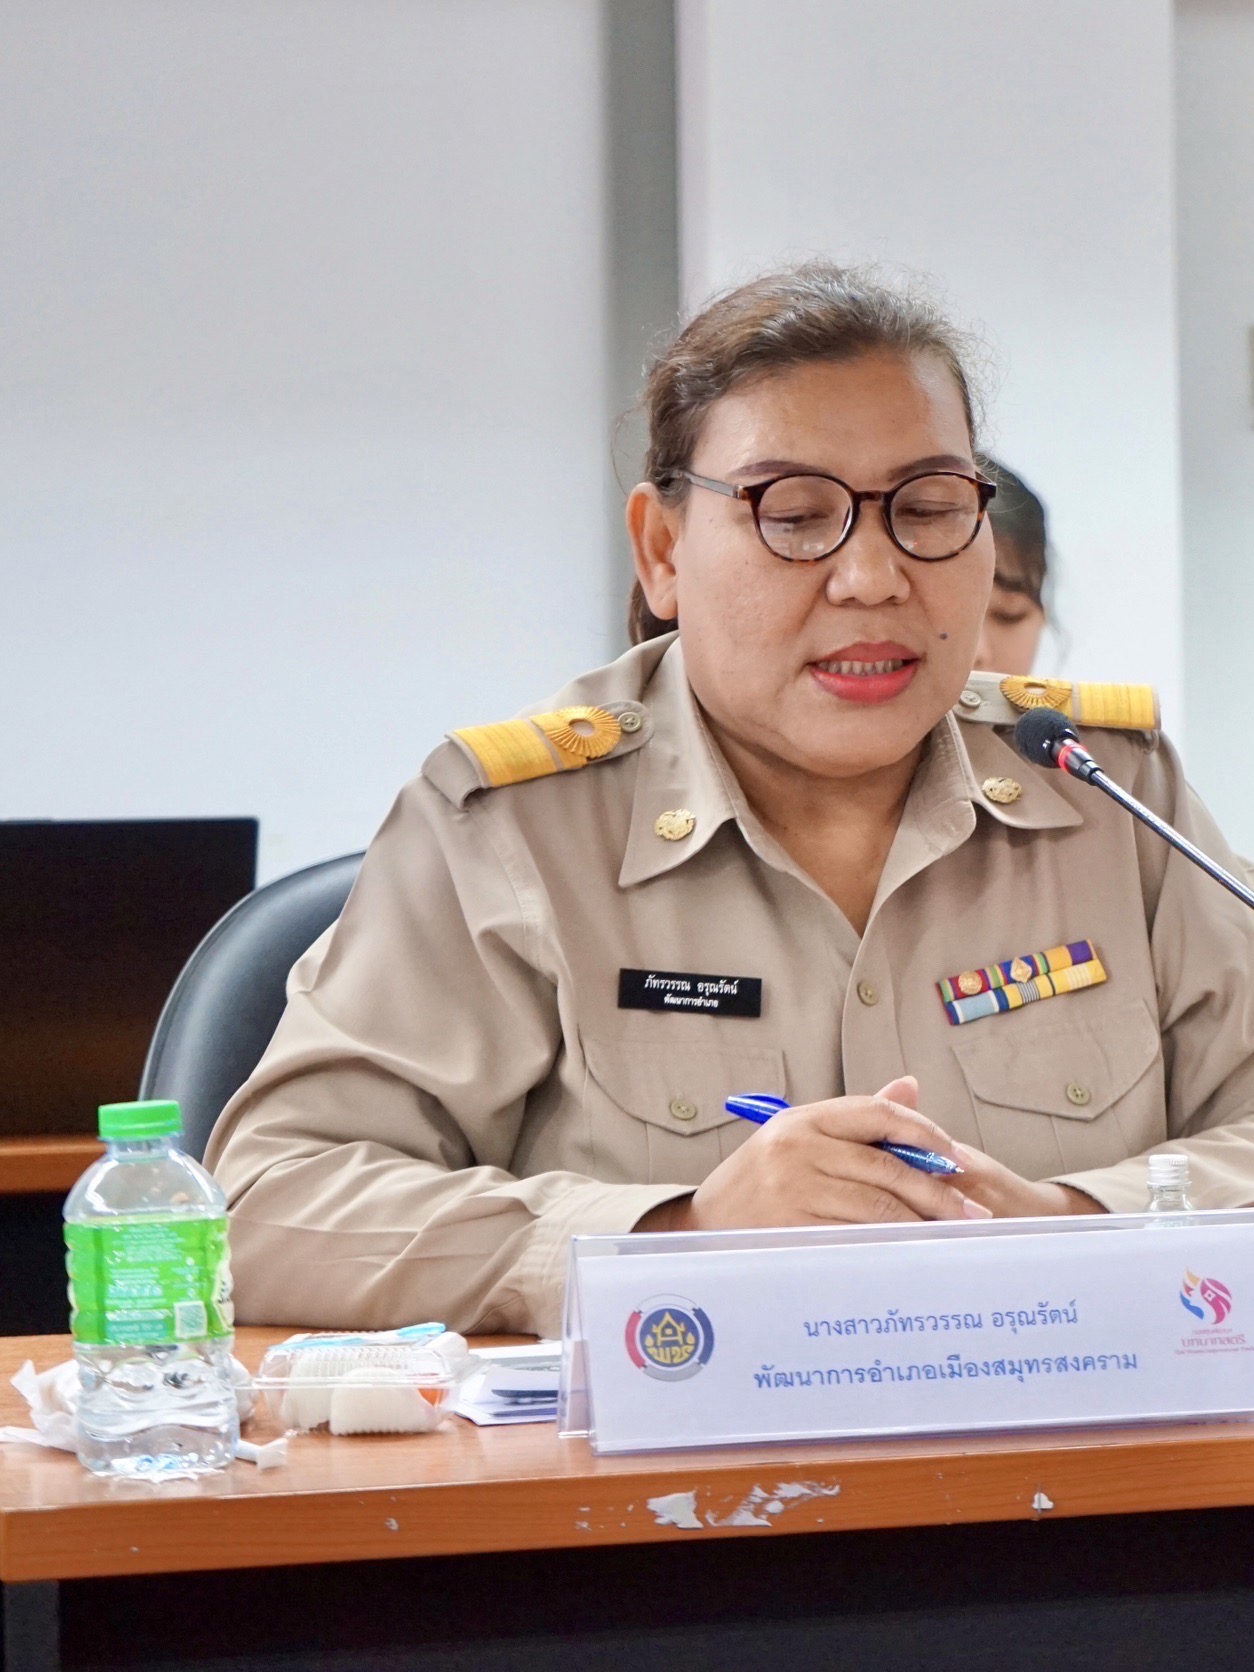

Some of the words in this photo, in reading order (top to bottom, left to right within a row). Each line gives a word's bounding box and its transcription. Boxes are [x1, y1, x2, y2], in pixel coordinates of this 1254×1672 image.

[644, 974, 691, 992] ภัทรวรรณ
[697, 979, 740, 996] อรุณรัตน์
[803, 1309, 983, 1337] นางสาวภัทรวรรณ
[992, 1299, 1078, 1335] อรุณรัตน์
[753, 1353, 1138, 1389] พัฒนาการอำเภอเมืองสมุทรสงคราม
